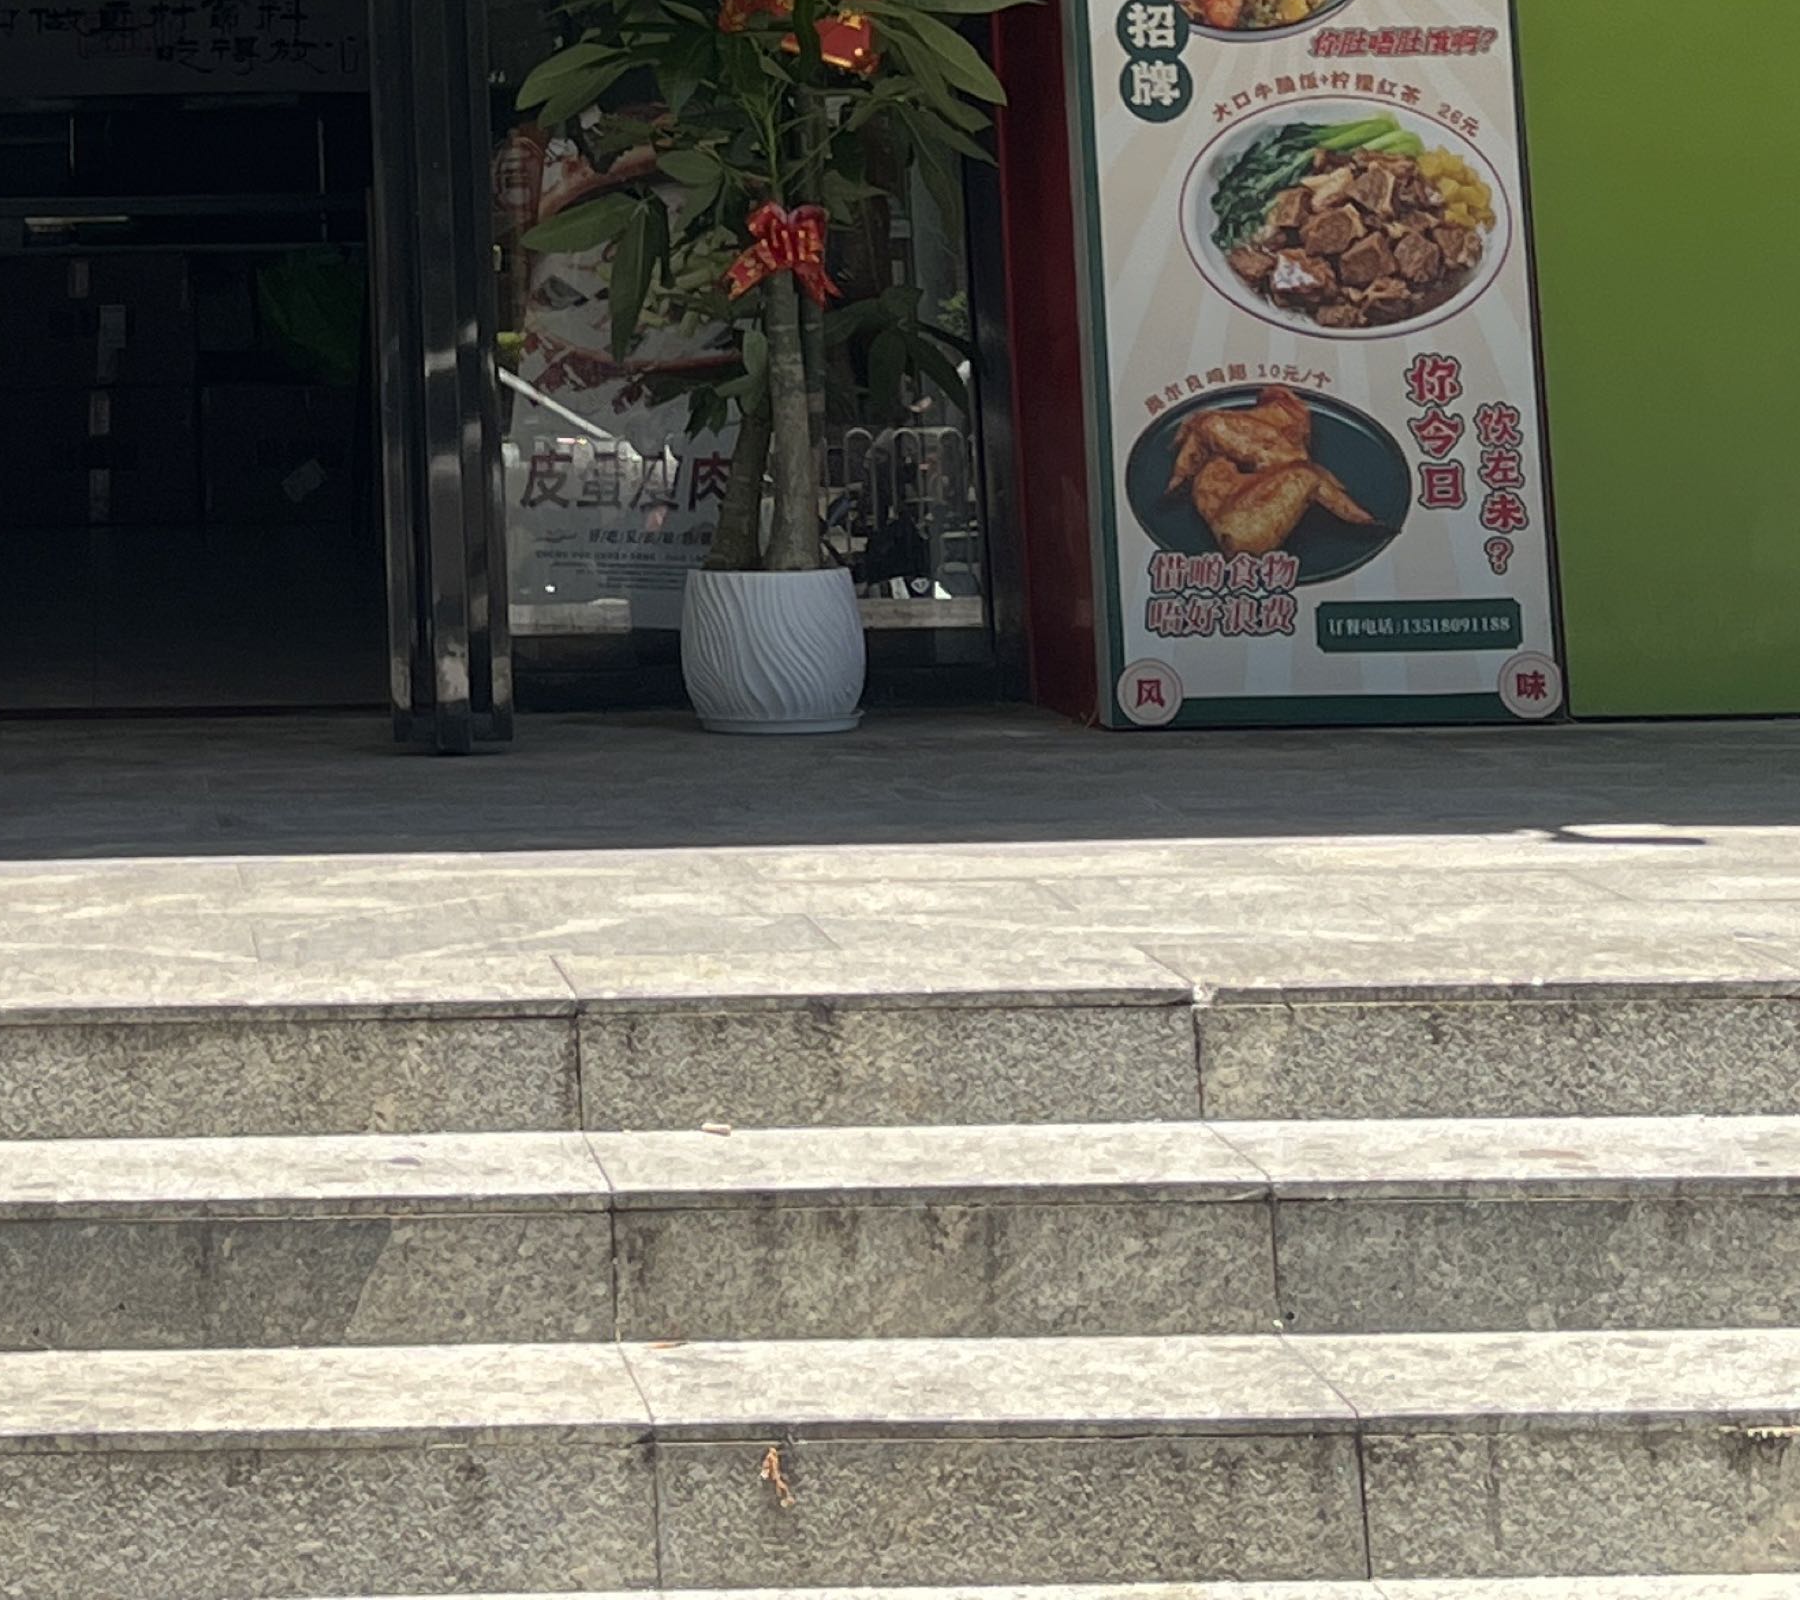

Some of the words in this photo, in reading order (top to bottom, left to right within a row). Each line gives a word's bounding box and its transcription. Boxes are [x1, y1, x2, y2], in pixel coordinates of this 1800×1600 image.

[1126, 2, 1181, 109] 招牌
[1404, 352, 1467, 510] 你今日
[1134, 678, 1166, 709] 风
[1515, 670, 1549, 701] 味
